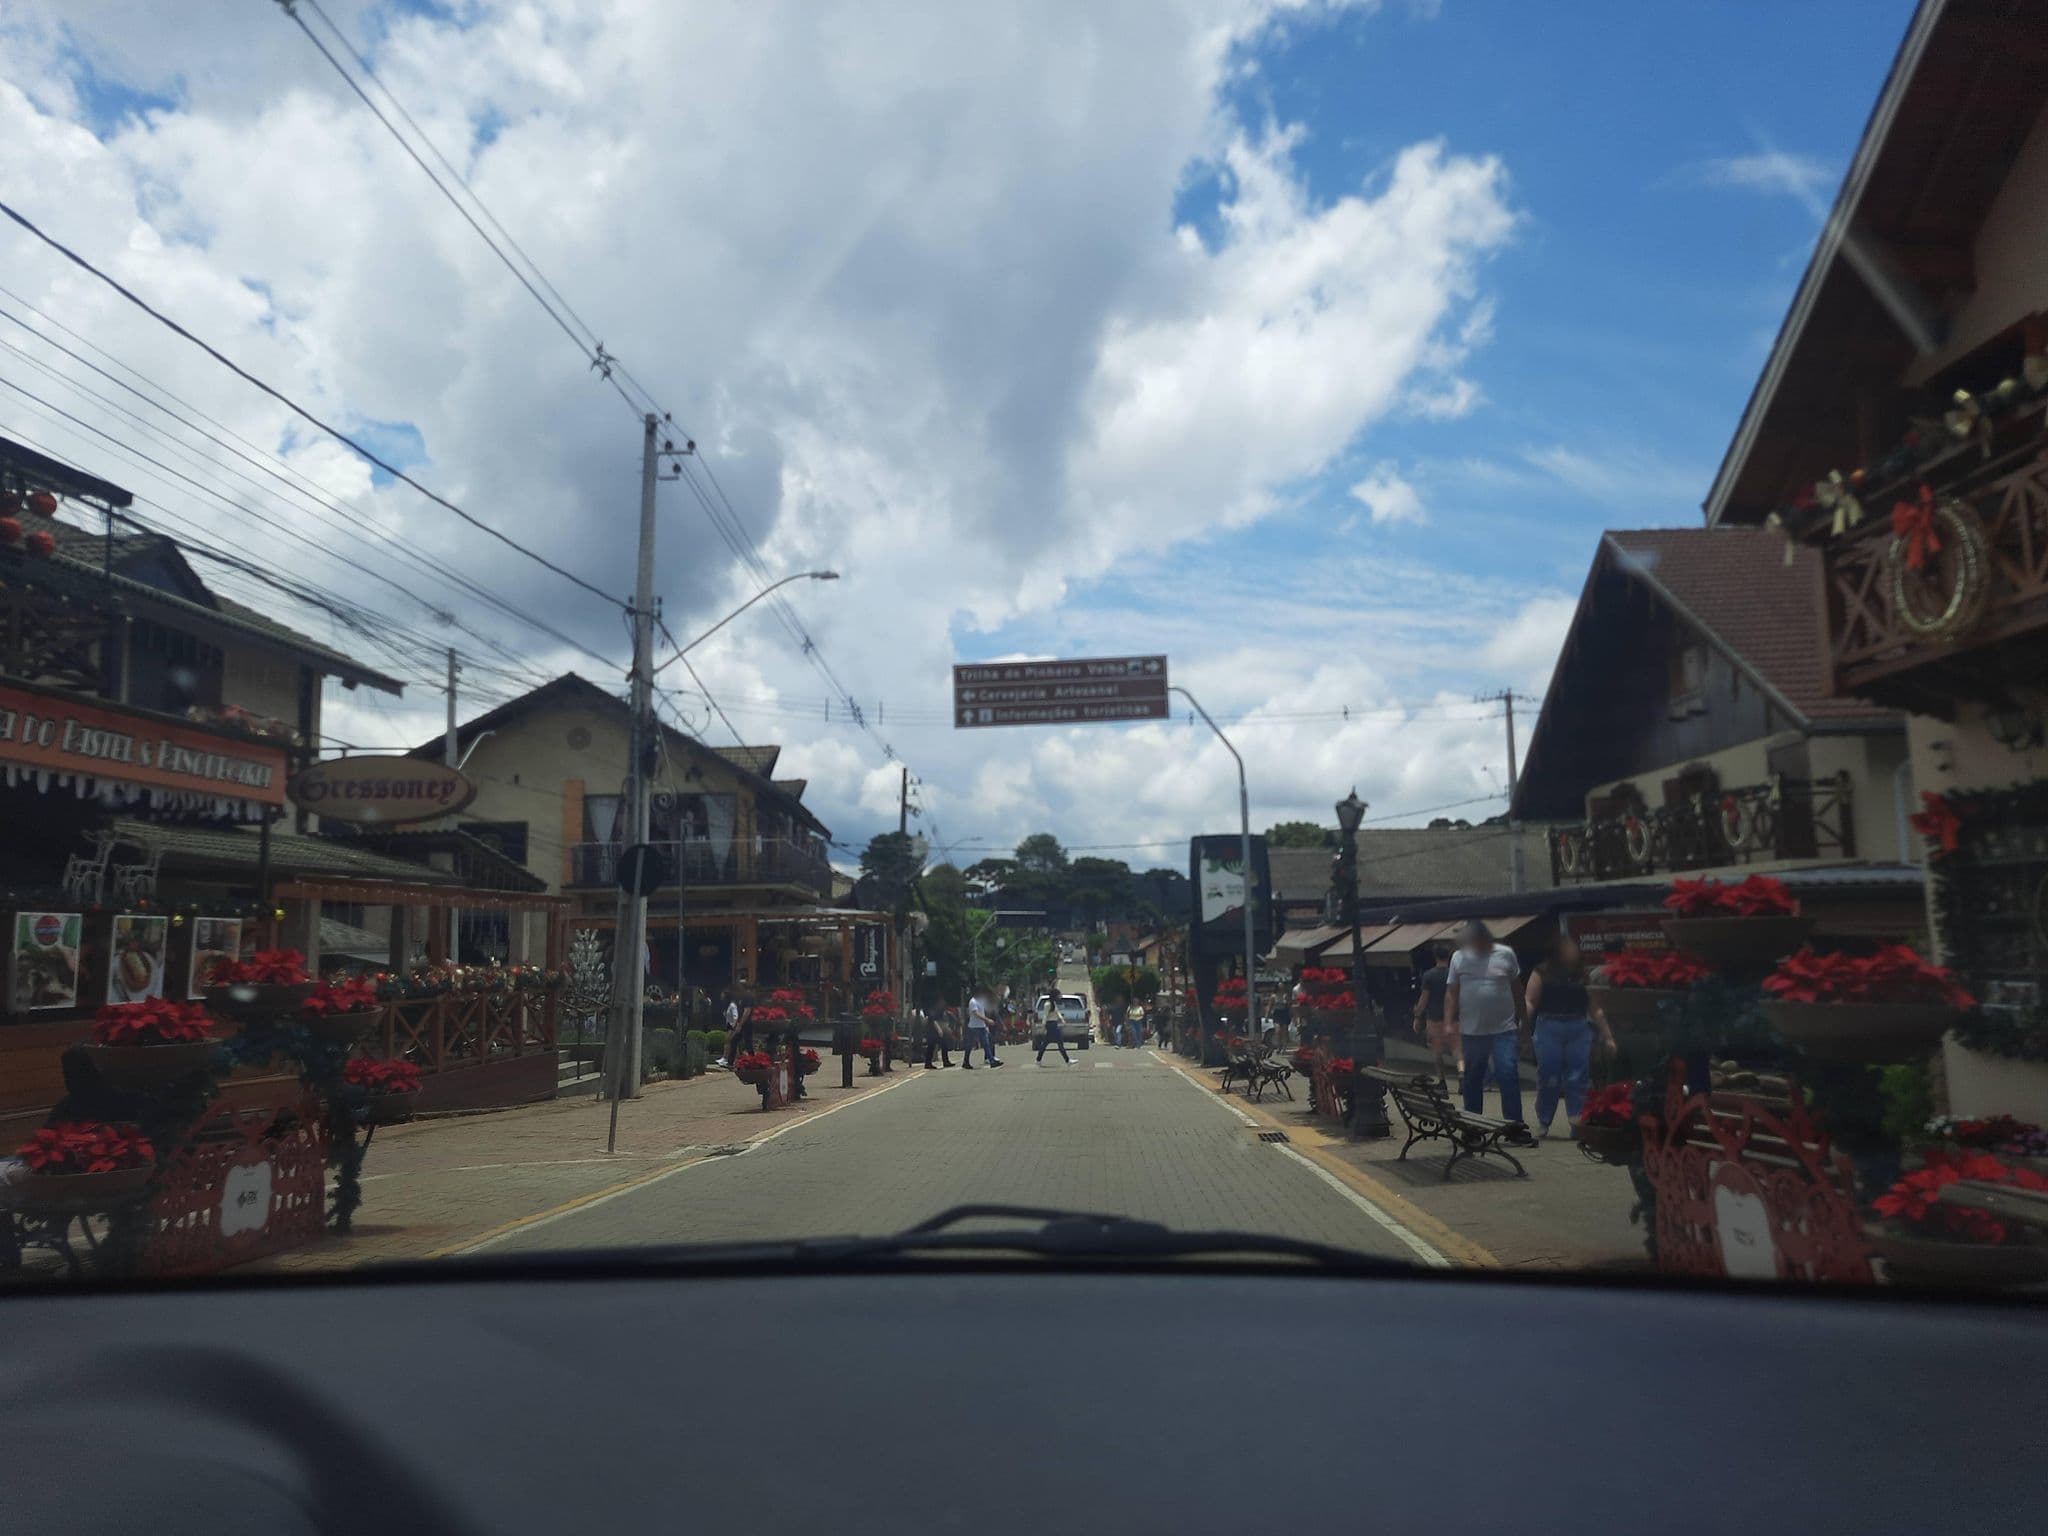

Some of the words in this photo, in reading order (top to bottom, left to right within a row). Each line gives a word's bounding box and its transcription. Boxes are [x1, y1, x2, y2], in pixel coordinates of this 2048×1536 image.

[979, 687, 1047, 701] Cervejaria
[1055, 684, 1119, 698] Artesanal
[996, 706, 1076, 721] Informações
[303, 769, 457, 805] Gressoney
